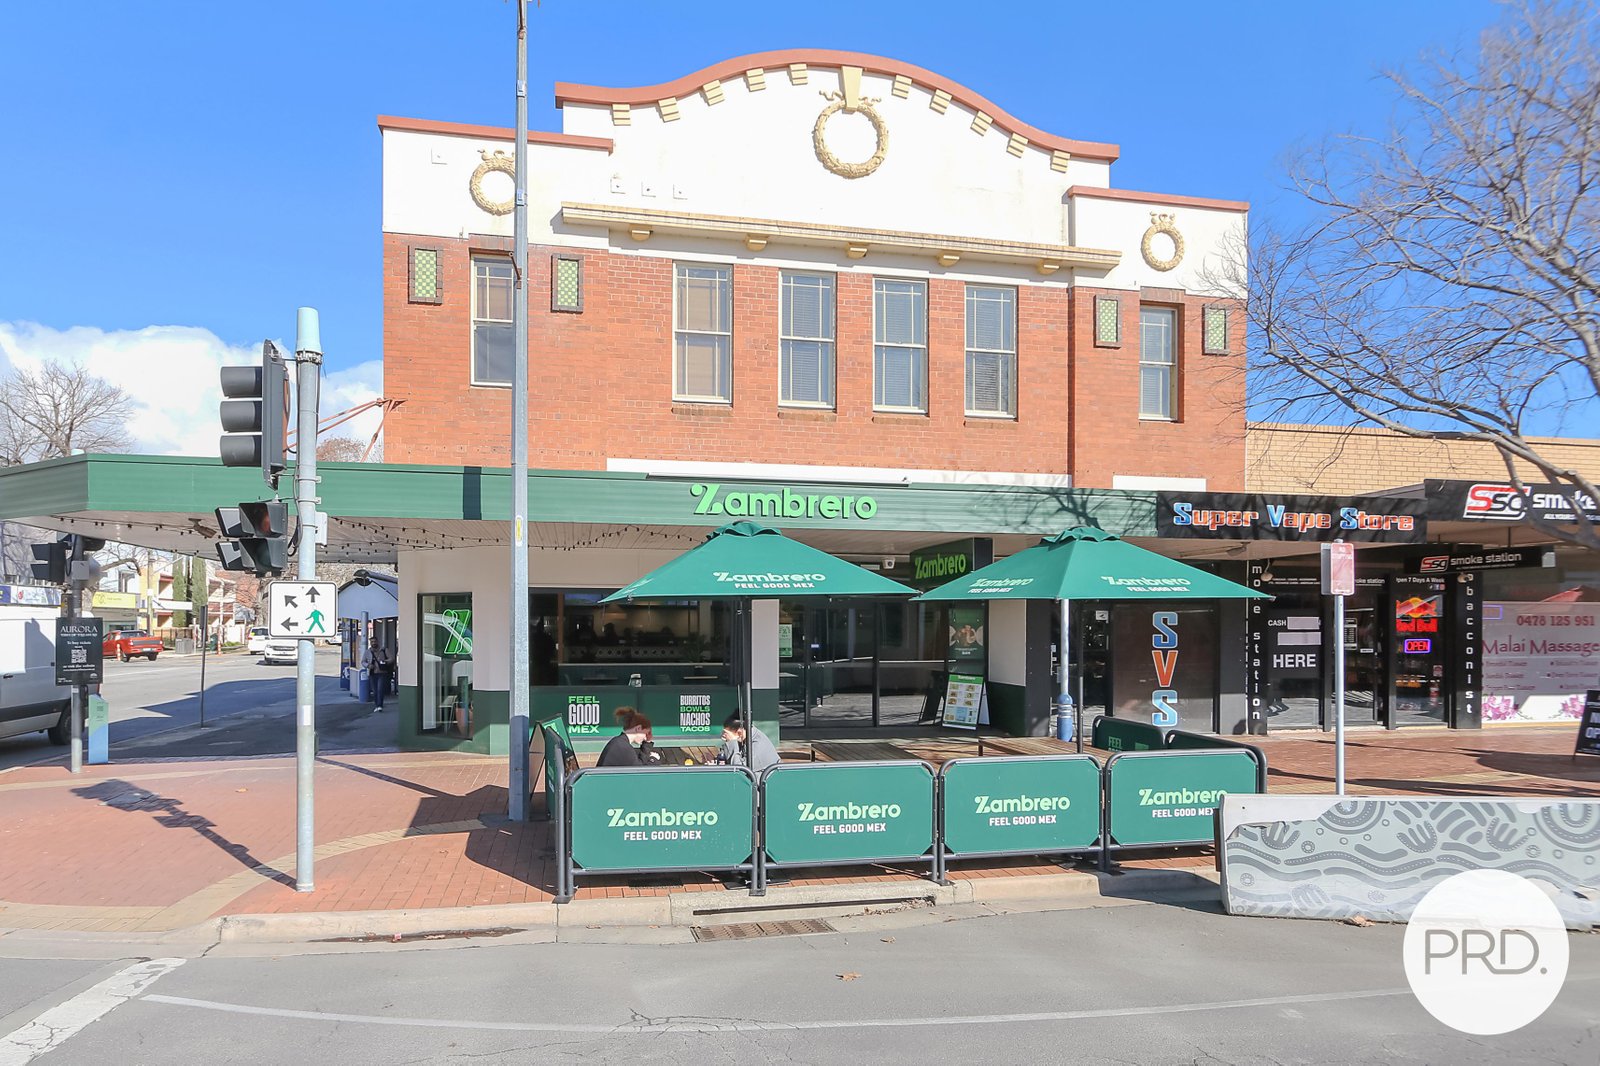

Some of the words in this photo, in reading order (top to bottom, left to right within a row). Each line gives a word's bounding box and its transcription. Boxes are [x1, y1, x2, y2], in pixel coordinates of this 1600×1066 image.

[690, 483, 878, 519] Zambrero
[1173, 502, 1259, 530] Super
[1266, 504, 1331, 532] Vape
[1340, 507, 1414, 530] Store
[915, 553, 966, 579] Zambrero
[1450, 555, 1483, 566] smoke
[1485, 553, 1521, 563] station
[713, 571, 826, 582] Zambrero
[969, 578, 1034, 587] Zambrero
[1101, 576, 1191, 586] Zambrero
[1516, 616, 1546, 626] 0478
[1551, 616, 1570, 626] 125
[1575, 616, 1595, 626] 951
[1407, 641, 1429, 651] OPEN
[1482, 634, 1526, 655] Malai
[1529, 639, 1600, 657] Massage
[1273, 654, 1316, 668] HERE
[1152, 611, 1178, 727] SVS
[680, 695, 710, 706] BURRITOS
[569, 704, 600, 725] GOOD
[680, 713, 710, 726] NACHOS
[569, 726, 600, 734] MEX
[974, 795, 1070, 814] Zambrero
[607, 808, 718, 827] Zambrero
[798, 802, 901, 821] Zambrero
[1152, 809, 1172, 818] FEEL
[1174, 808, 1196, 817] GOOD
[989, 818, 1010, 826] FEEL
[1012, 816, 1036, 825] GOOD
[1038, 815, 1057, 824] MEX
[814, 824, 837, 834] FEEL
[839, 824, 862, 834] GOOD
[864, 822, 886, 832] MEX
[624, 832, 648, 841] FEEL
[651, 832, 678, 840] GOOD
[681, 830, 702, 840] MEX
